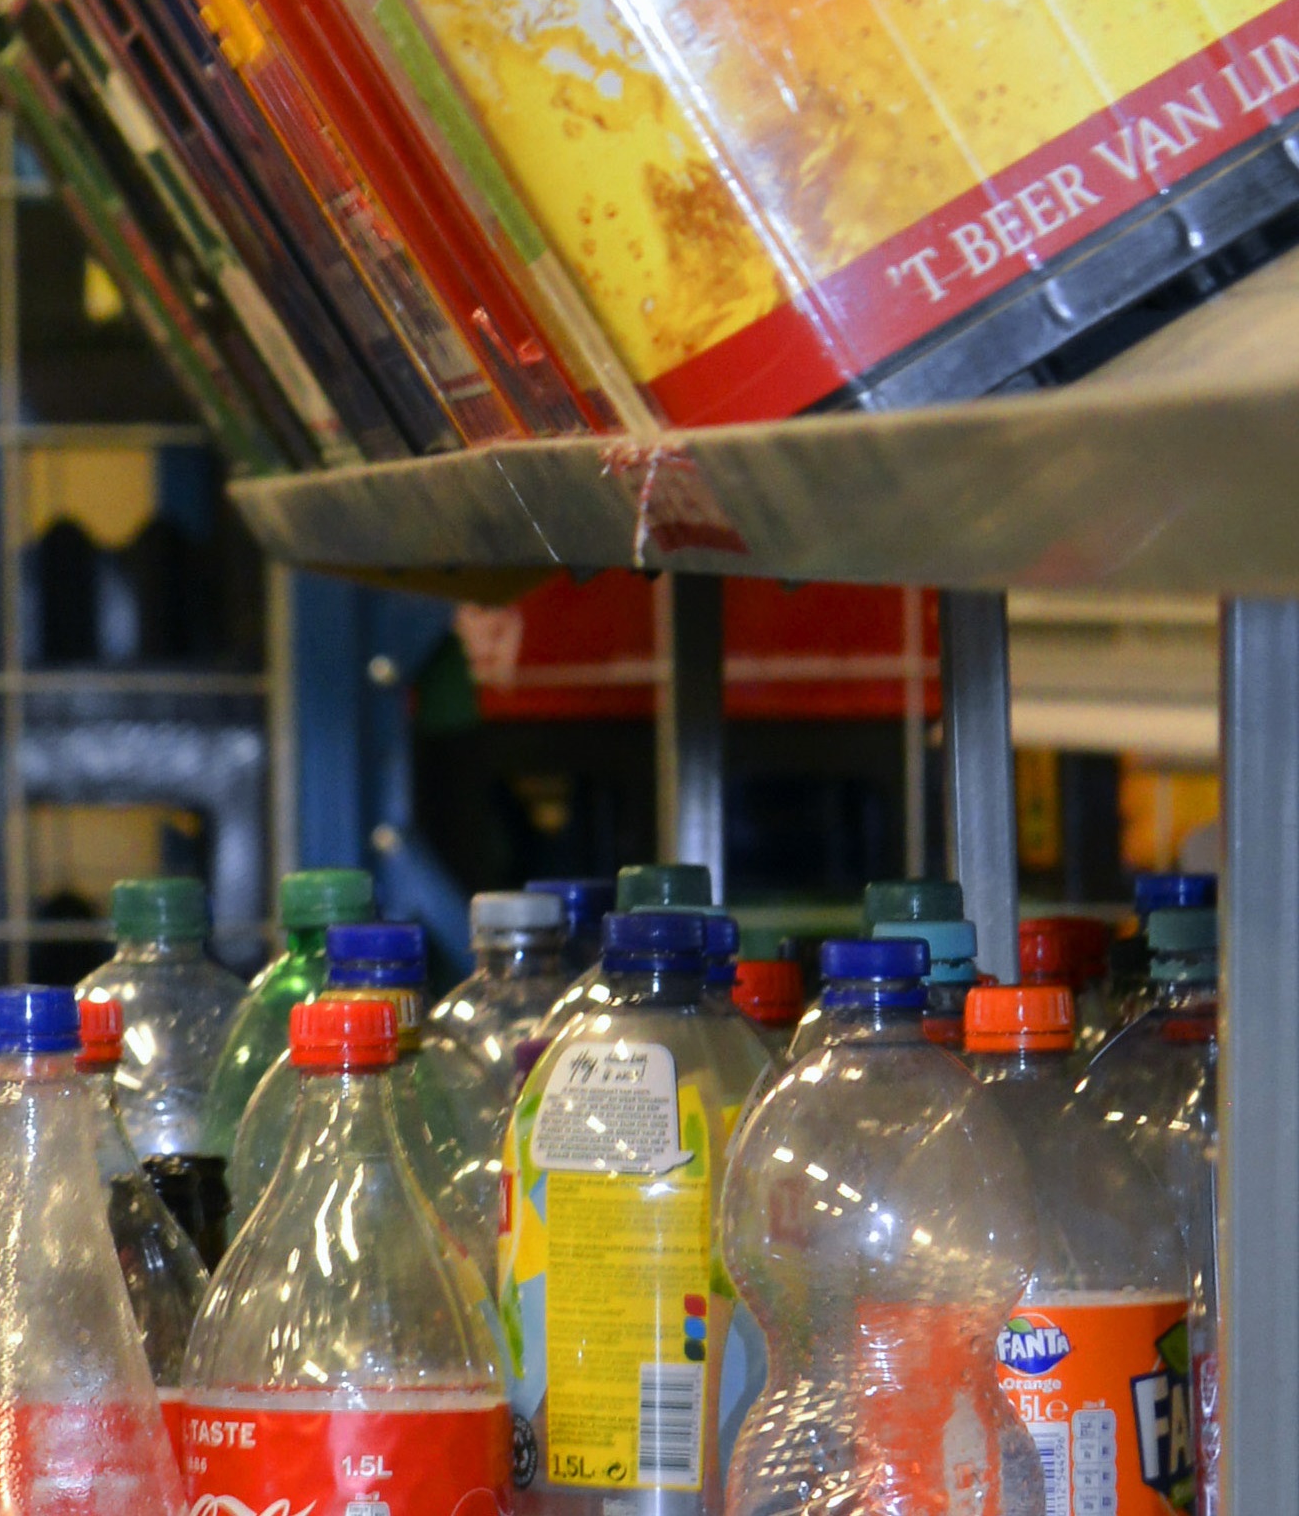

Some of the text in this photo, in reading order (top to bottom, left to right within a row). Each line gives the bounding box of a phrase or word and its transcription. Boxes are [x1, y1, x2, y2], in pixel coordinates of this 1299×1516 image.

[949, 164, 1103, 279] BEER
[1092, 84, 1223, 182] VAN
[995, 1327, 1071, 1362] FANTA
[1003, 1377, 1063, 1394] Orange
[190, 1418, 257, 1449] TASTE
[341, 1454, 394, 1479] 1.5L
